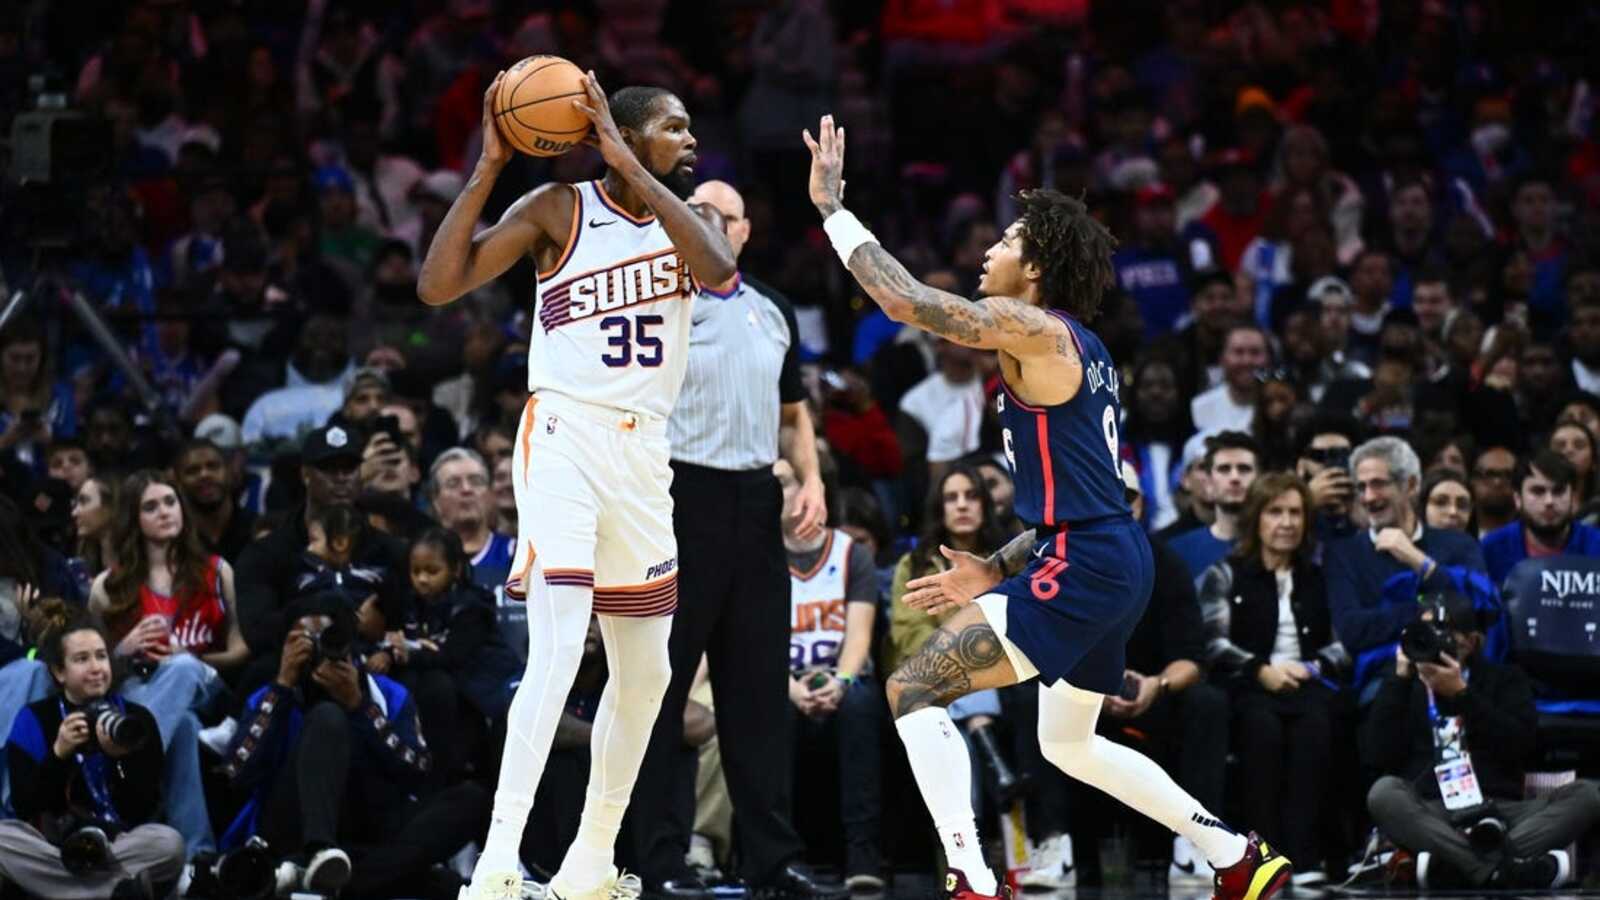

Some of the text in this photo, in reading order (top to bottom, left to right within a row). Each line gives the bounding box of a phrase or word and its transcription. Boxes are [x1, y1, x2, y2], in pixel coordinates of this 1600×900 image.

[568, 254, 678, 320] SUNS
[600, 315, 663, 368] 35
[645, 558, 676, 581] PHOE
